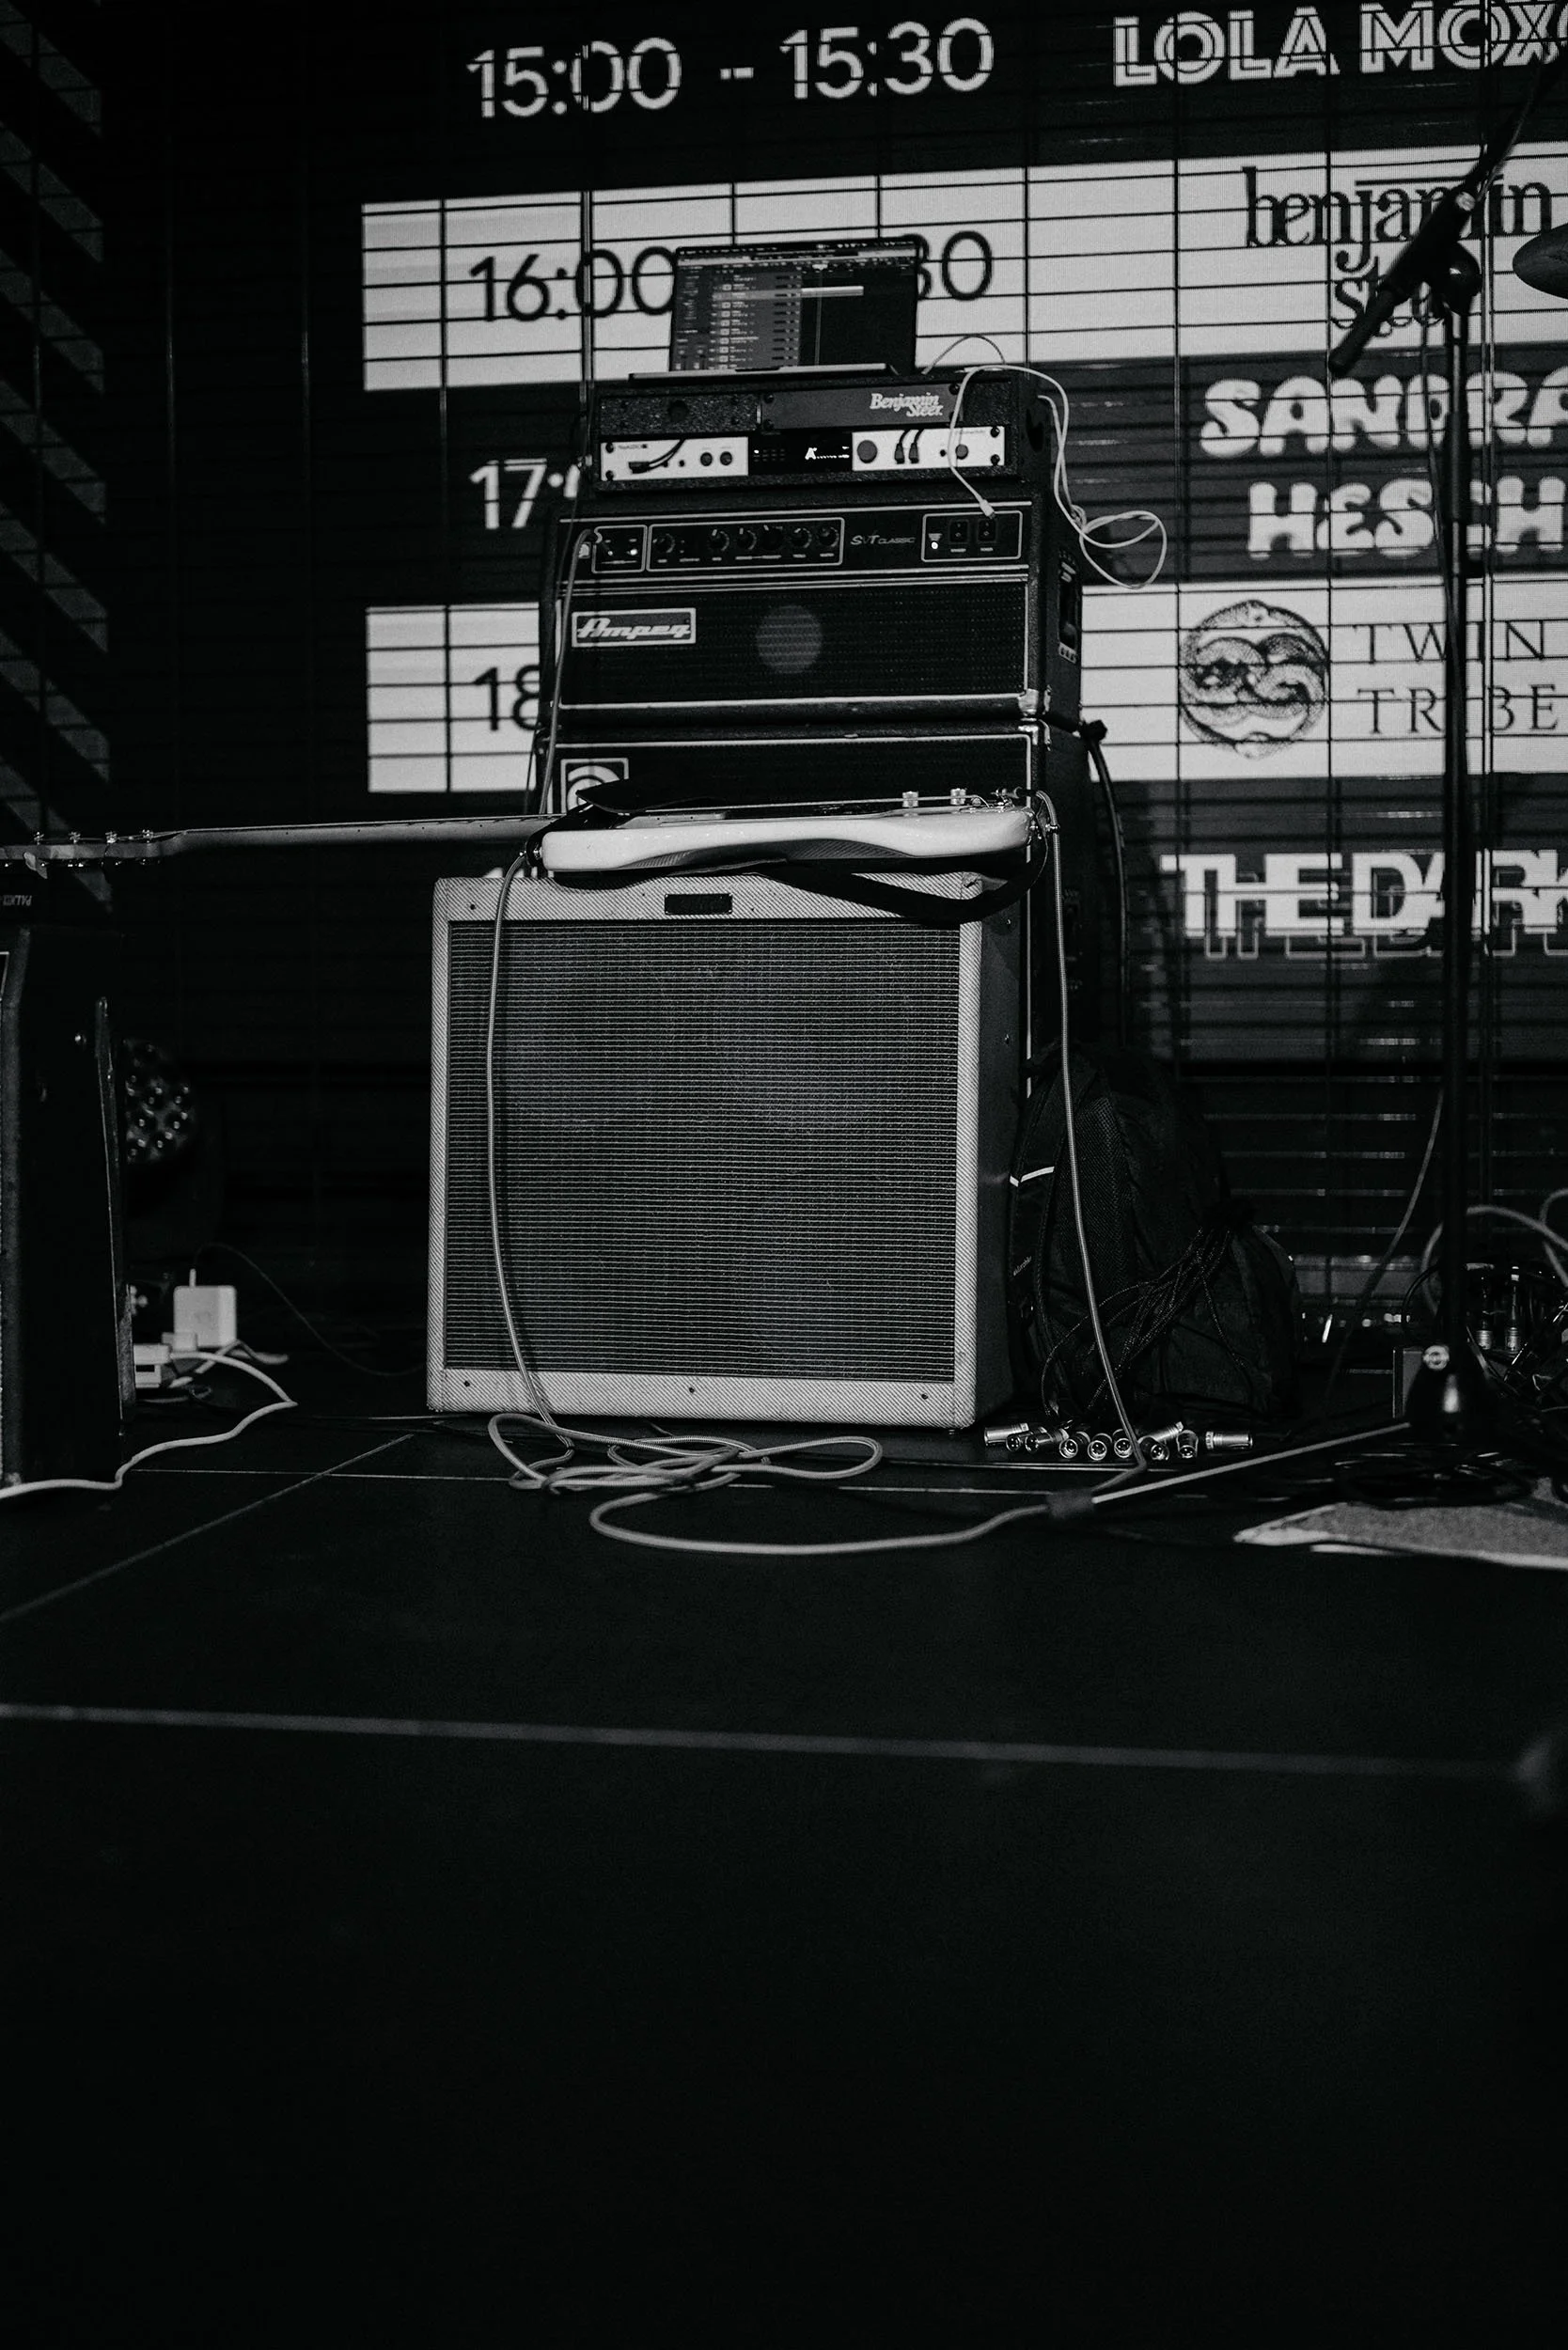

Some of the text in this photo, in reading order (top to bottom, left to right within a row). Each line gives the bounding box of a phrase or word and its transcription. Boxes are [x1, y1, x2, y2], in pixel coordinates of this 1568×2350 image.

[466, 38, 681, 118] 15:00
[779, 18, 995, 99] 15:30
[1113, 0, 1568, 86] LOLA MOX
[469, 245, 675, 322] 16:00
[870, 391, 939, 412] Benjamin
[576, 617, 692, 640] Ampeg
[1352, 618, 1546, 665] TWIN
[1357, 682, 1558, 734] TRBE
